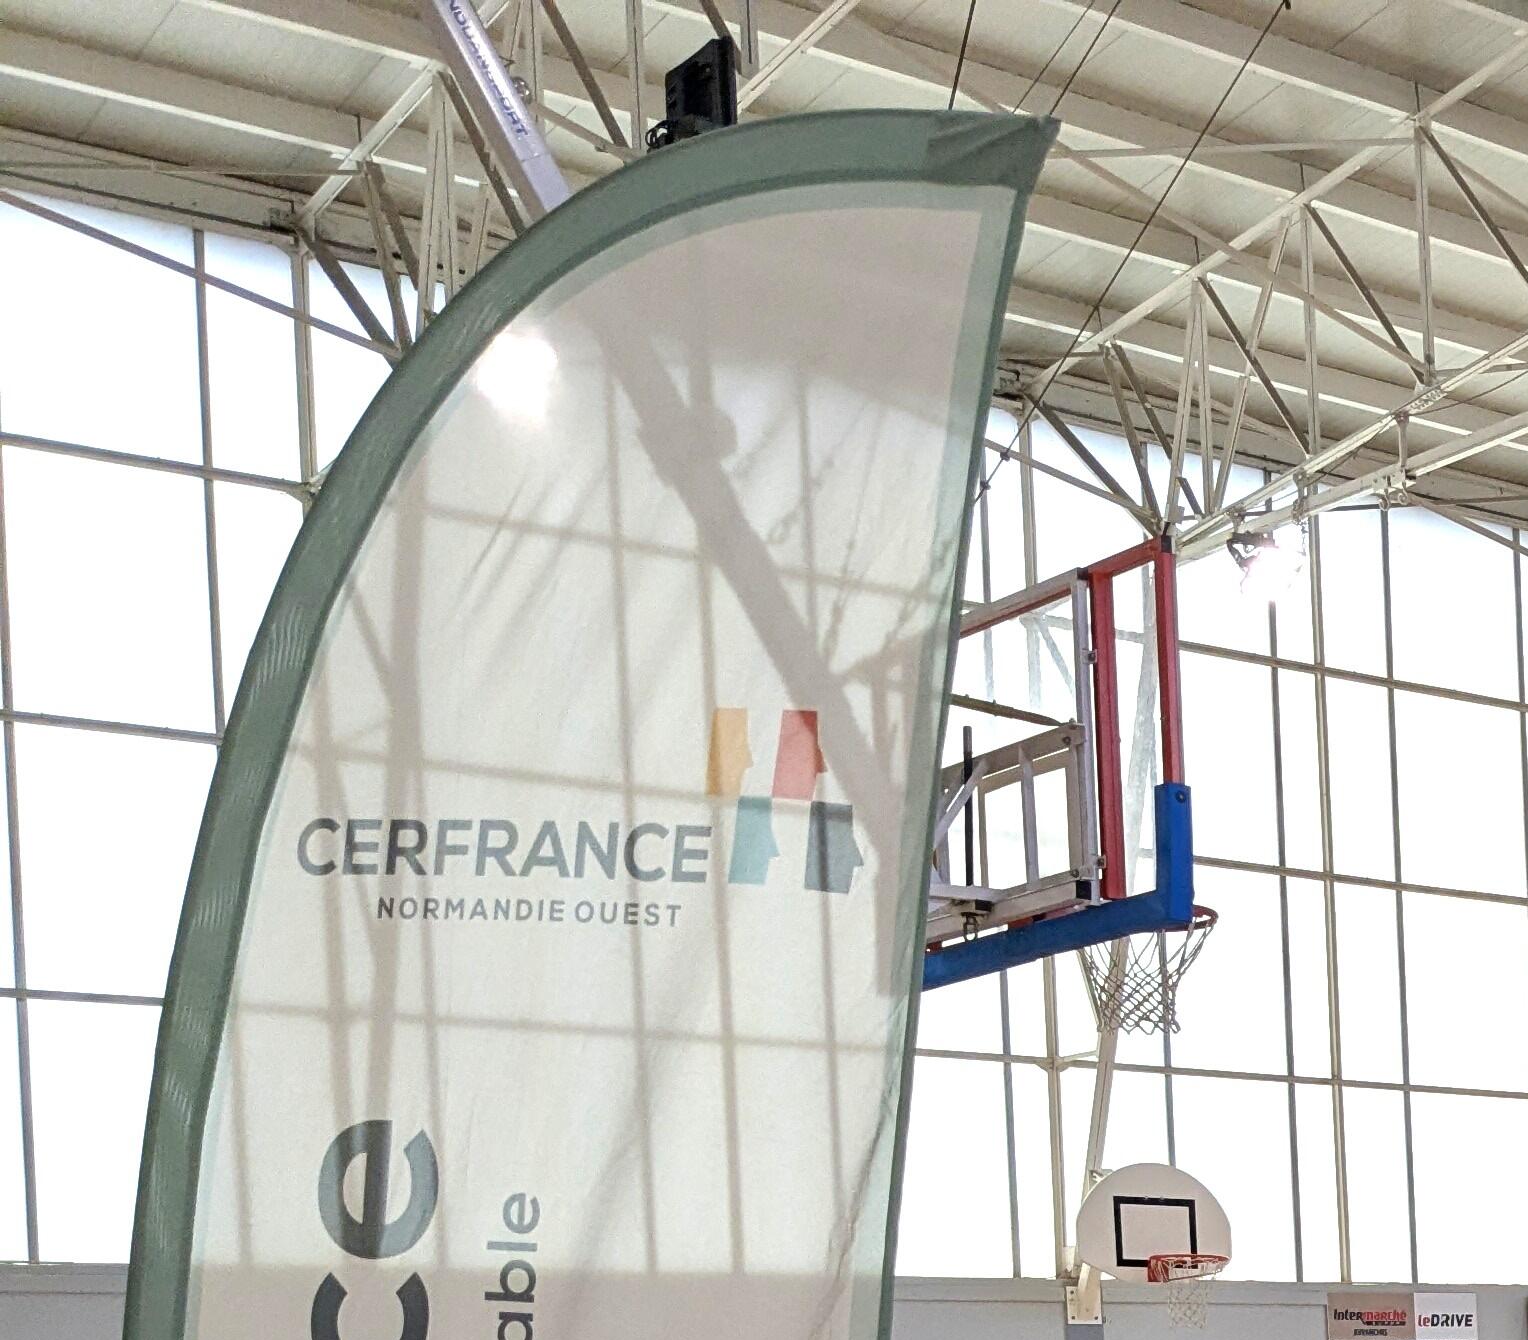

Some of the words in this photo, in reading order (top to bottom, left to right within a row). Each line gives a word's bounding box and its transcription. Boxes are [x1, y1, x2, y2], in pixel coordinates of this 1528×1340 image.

[297, 817, 713, 884] CERFRANCE
[376, 896, 565, 924] NORMANDIE
[574, 900, 683, 928] OUEST
